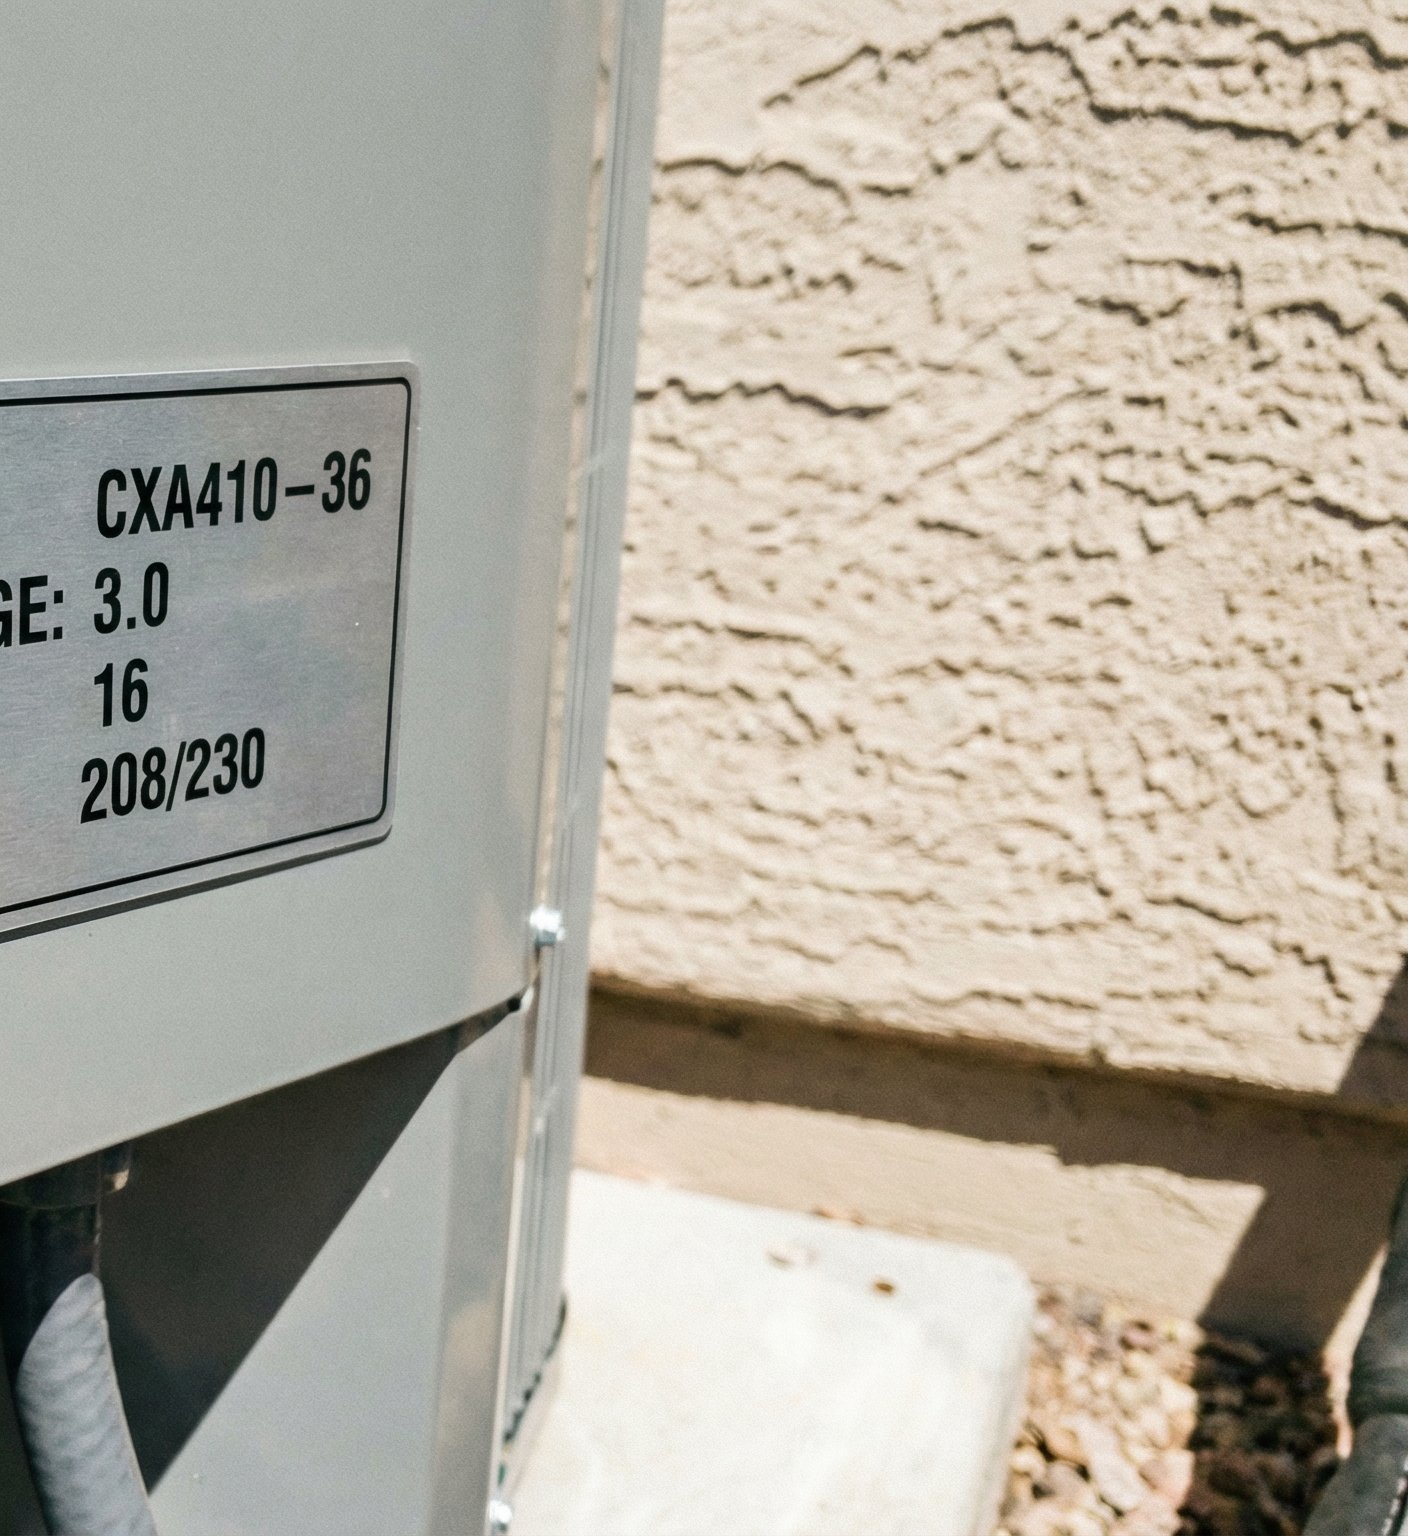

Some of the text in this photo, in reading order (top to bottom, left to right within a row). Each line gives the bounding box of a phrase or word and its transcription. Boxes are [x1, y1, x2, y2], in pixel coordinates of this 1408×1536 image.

[93, 561, 170, 635] 3.0
[93, 657, 149, 728] 16
[79, 726, 266, 825] 208/230
